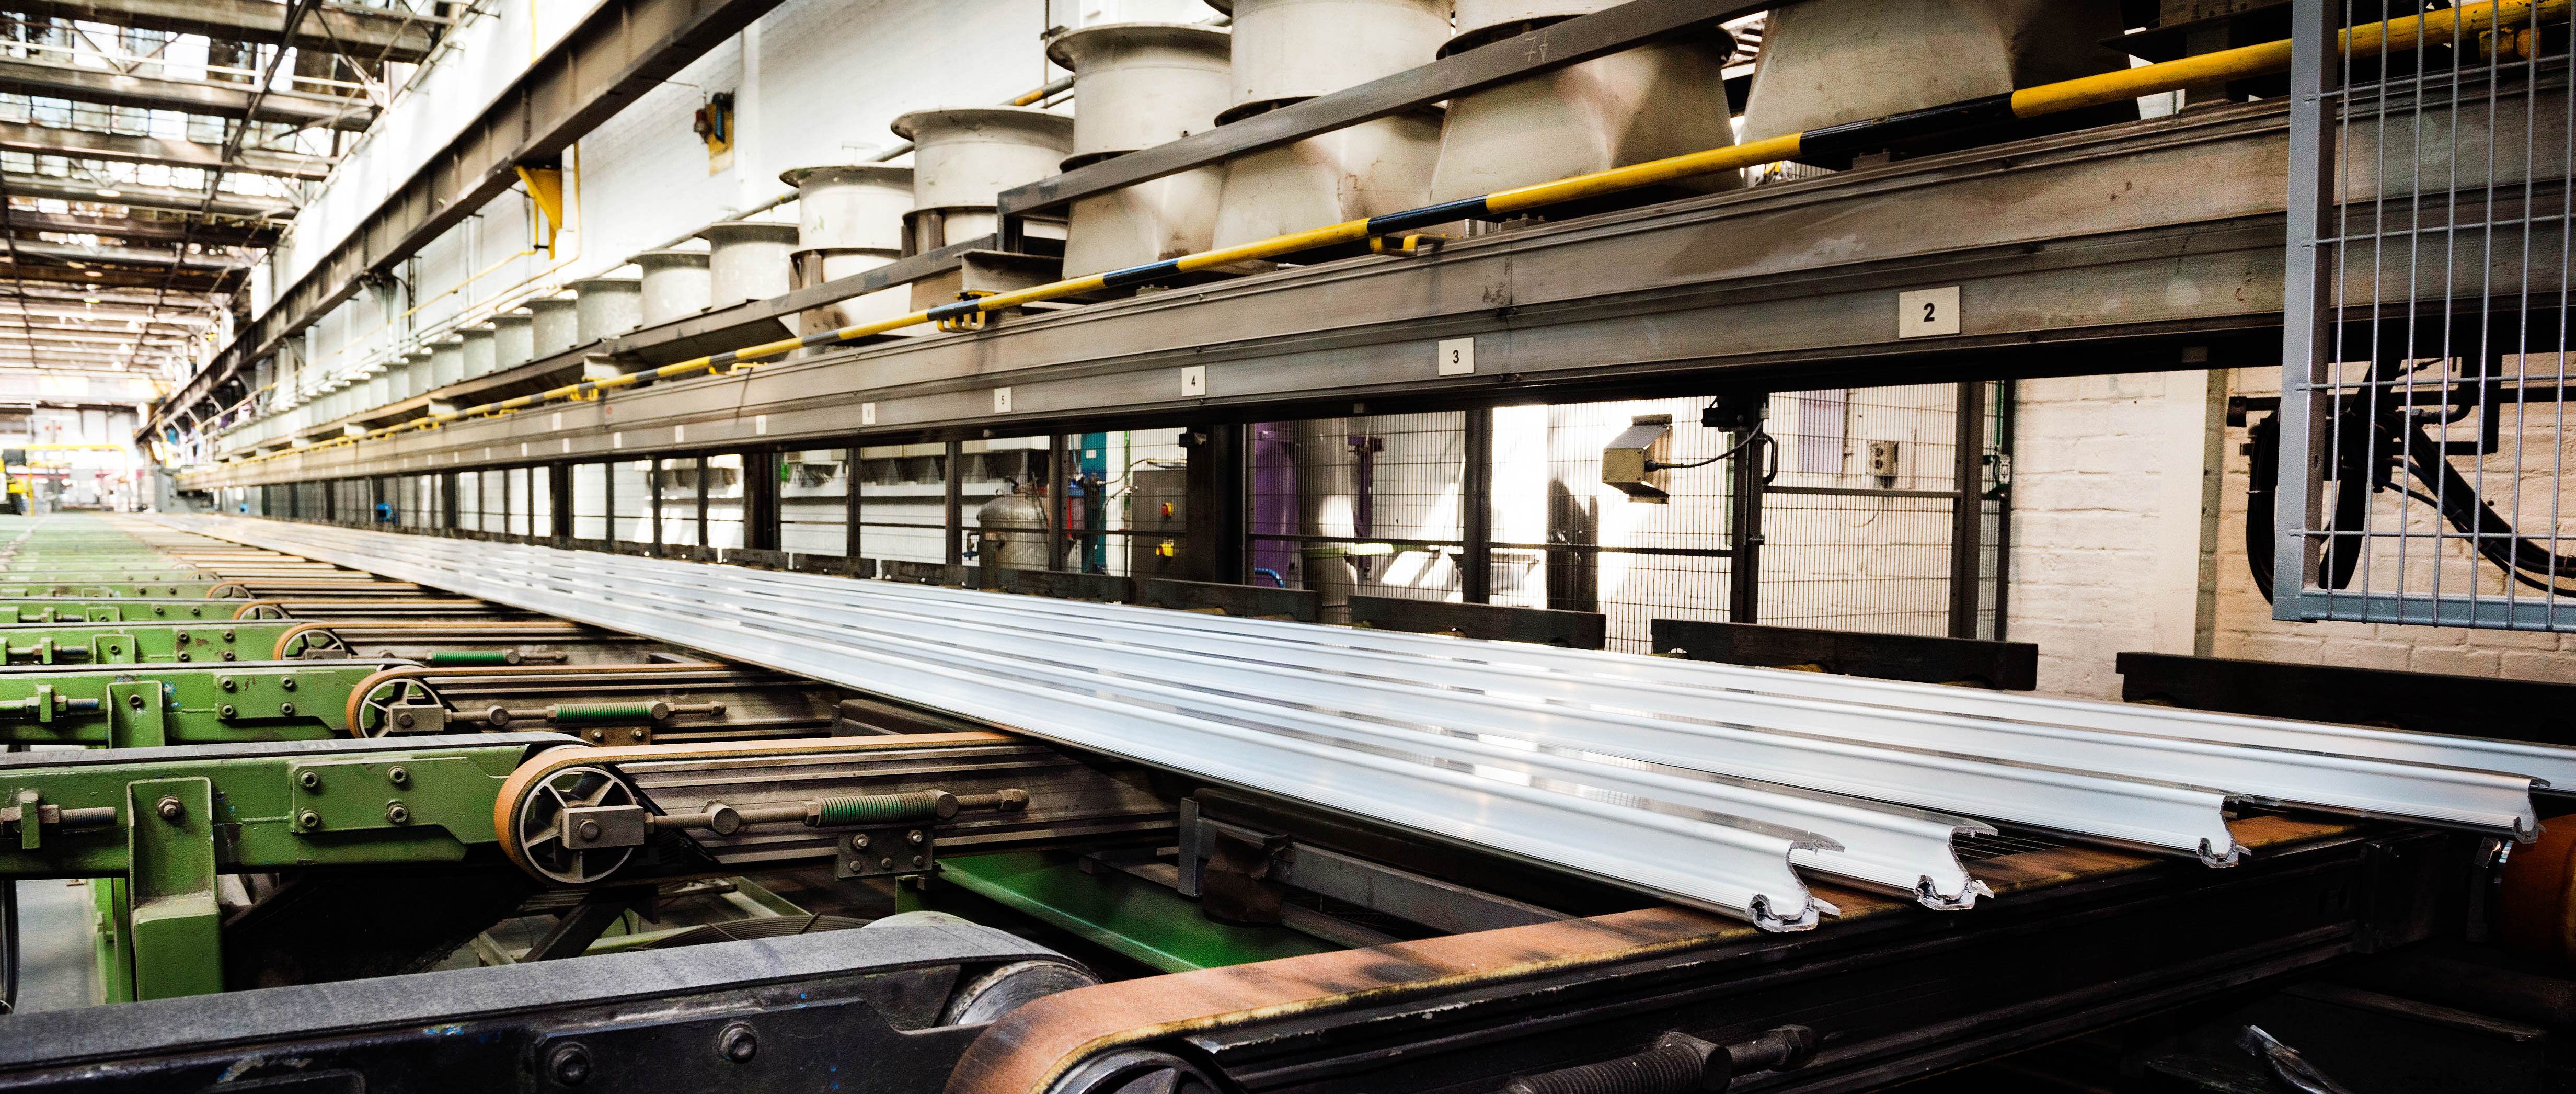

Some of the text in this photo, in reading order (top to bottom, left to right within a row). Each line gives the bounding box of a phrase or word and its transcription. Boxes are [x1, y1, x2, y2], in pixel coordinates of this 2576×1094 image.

[1923, 303, 1935, 323] 2
[1453, 349, 1459, 364] 3
[1191, 375, 1196, 387] 4
[1001, 395, 1005, 405] 5
